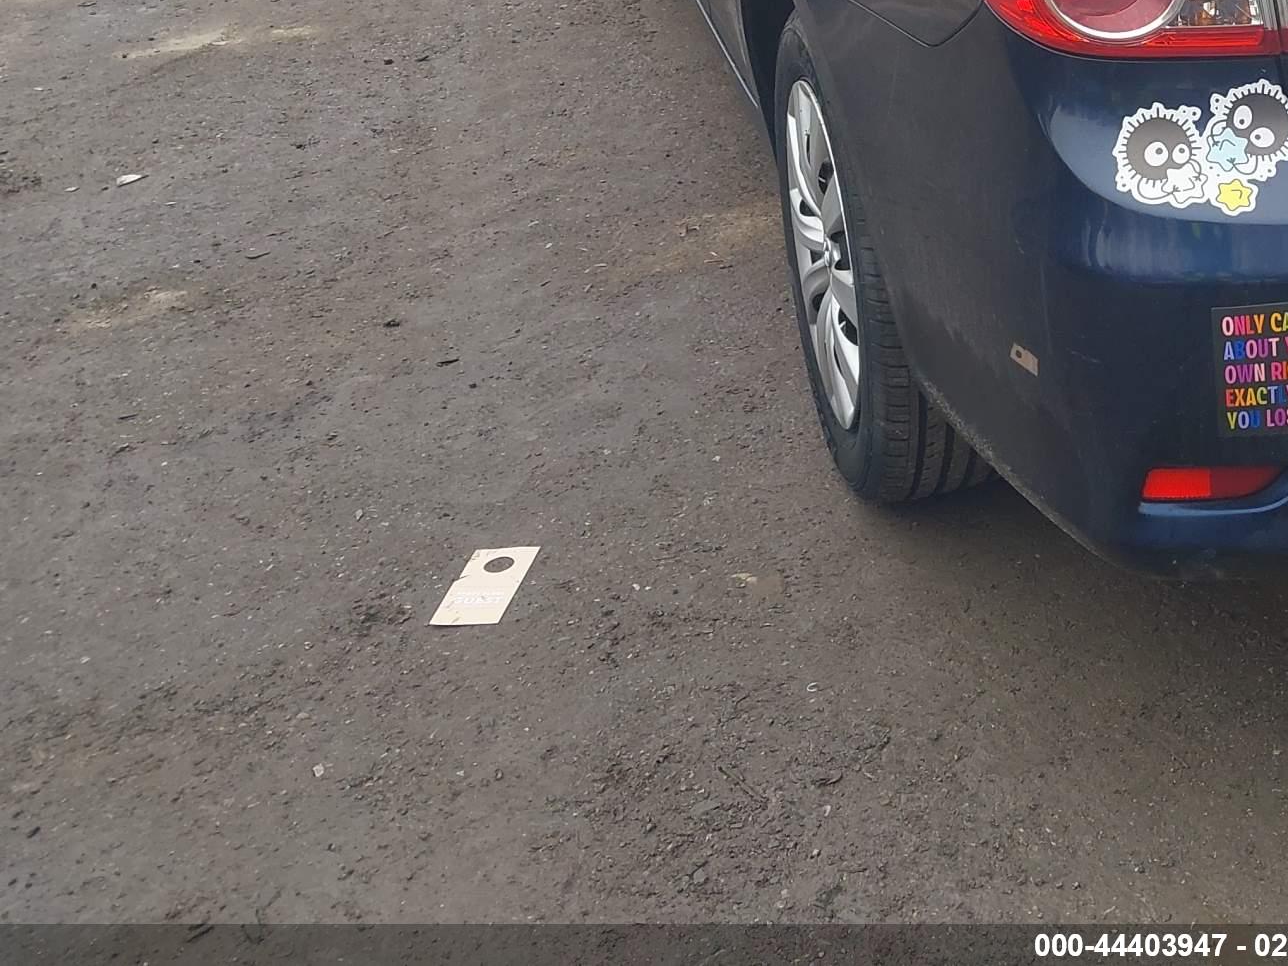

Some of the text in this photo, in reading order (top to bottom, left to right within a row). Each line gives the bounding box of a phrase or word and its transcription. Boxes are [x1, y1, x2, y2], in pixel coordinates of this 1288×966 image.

[1222, 314, 1265, 336] ONLY
[1224, 337, 1280, 361] ABOUT
[1224, 363, 1266, 384] OWN
[1227, 410, 1260, 430] YOU
